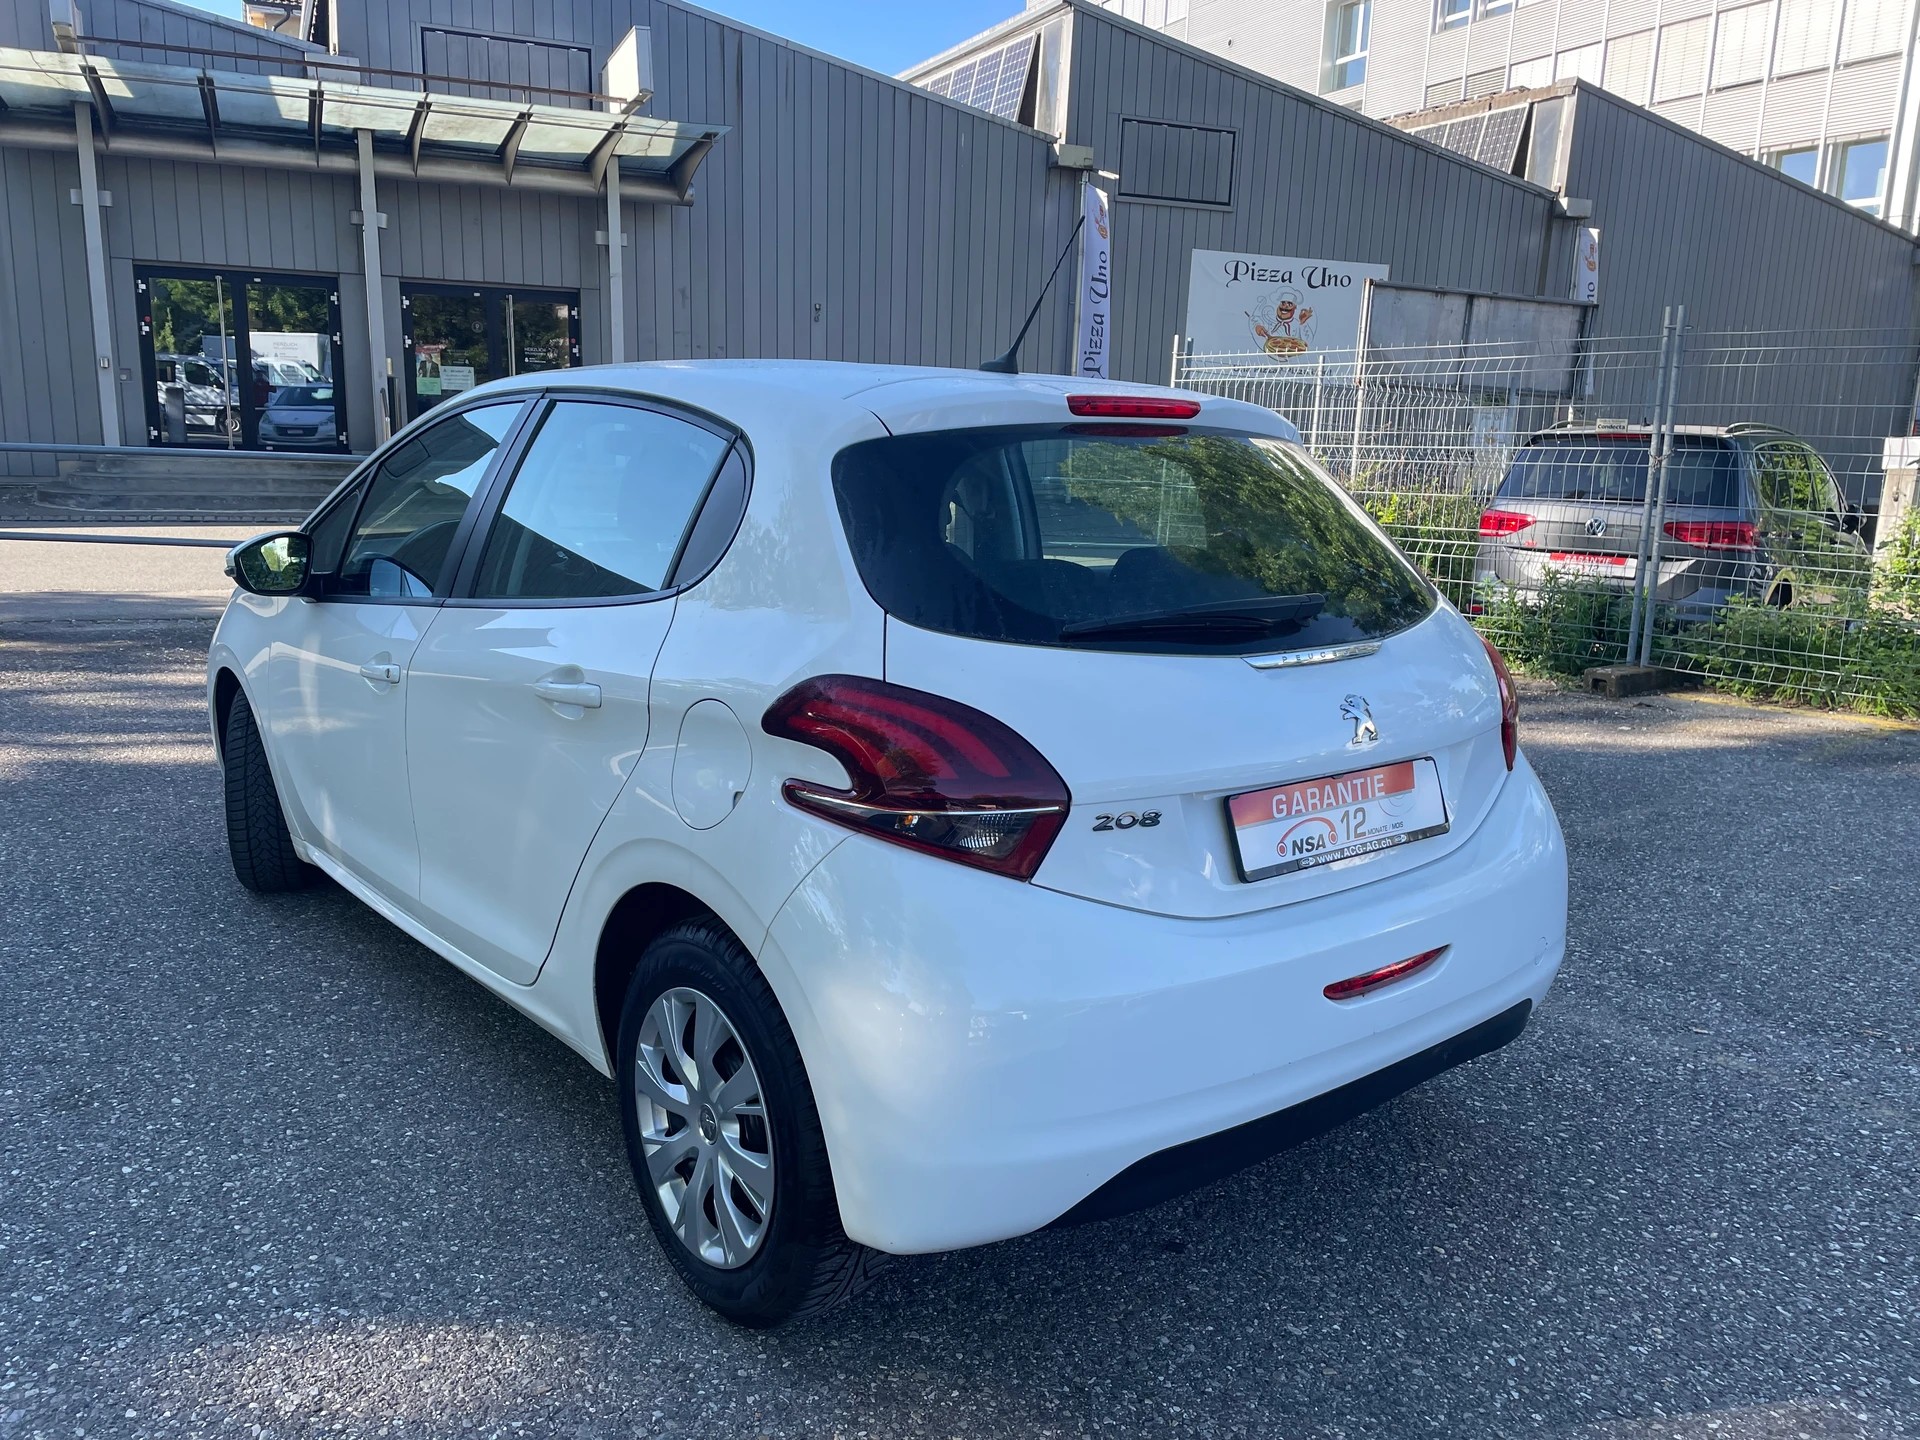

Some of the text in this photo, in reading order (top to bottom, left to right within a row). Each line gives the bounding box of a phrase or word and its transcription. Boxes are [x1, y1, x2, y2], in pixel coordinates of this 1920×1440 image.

[1224, 260, 1352, 289] Pizza Uno
[1083, 251, 1108, 379] Pizza Uno
[1564, 554, 1612, 564] GARANTIE
[1272, 774, 1385, 819] GARANTIE
[1092, 808, 1162, 831] 208
[1340, 806, 1367, 841] 12
[1366, 824, 1388, 835] MONATE
[1391, 821, 1404, 829] MOIS
[1291, 836, 1327, 856] NSA
[1316, 838, 1392, 864] www.ACG-AG.ch
